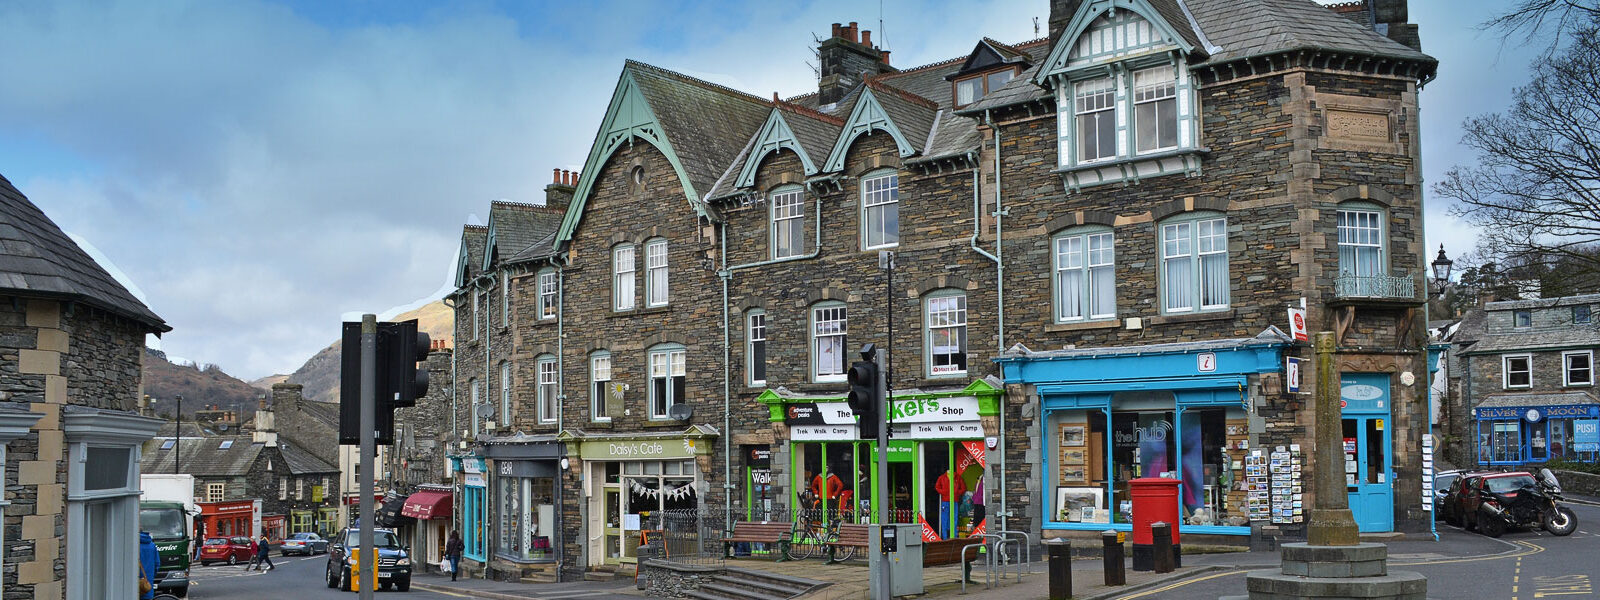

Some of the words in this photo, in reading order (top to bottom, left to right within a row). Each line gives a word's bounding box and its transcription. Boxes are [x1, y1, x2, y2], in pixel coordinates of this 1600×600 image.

[836, 410, 851, 418] The
[942, 407, 964, 415] Shop
[1480, 409, 1518, 418] SILVER
[1547, 407, 1587, 416] MOON
[1132, 420, 1167, 442] hub
[1575, 423, 1597, 434] PUSH
[609, 442, 638, 456] Daisy's
[639, 442, 663, 455] Cafe
[501, 461, 513, 475] GEAR
